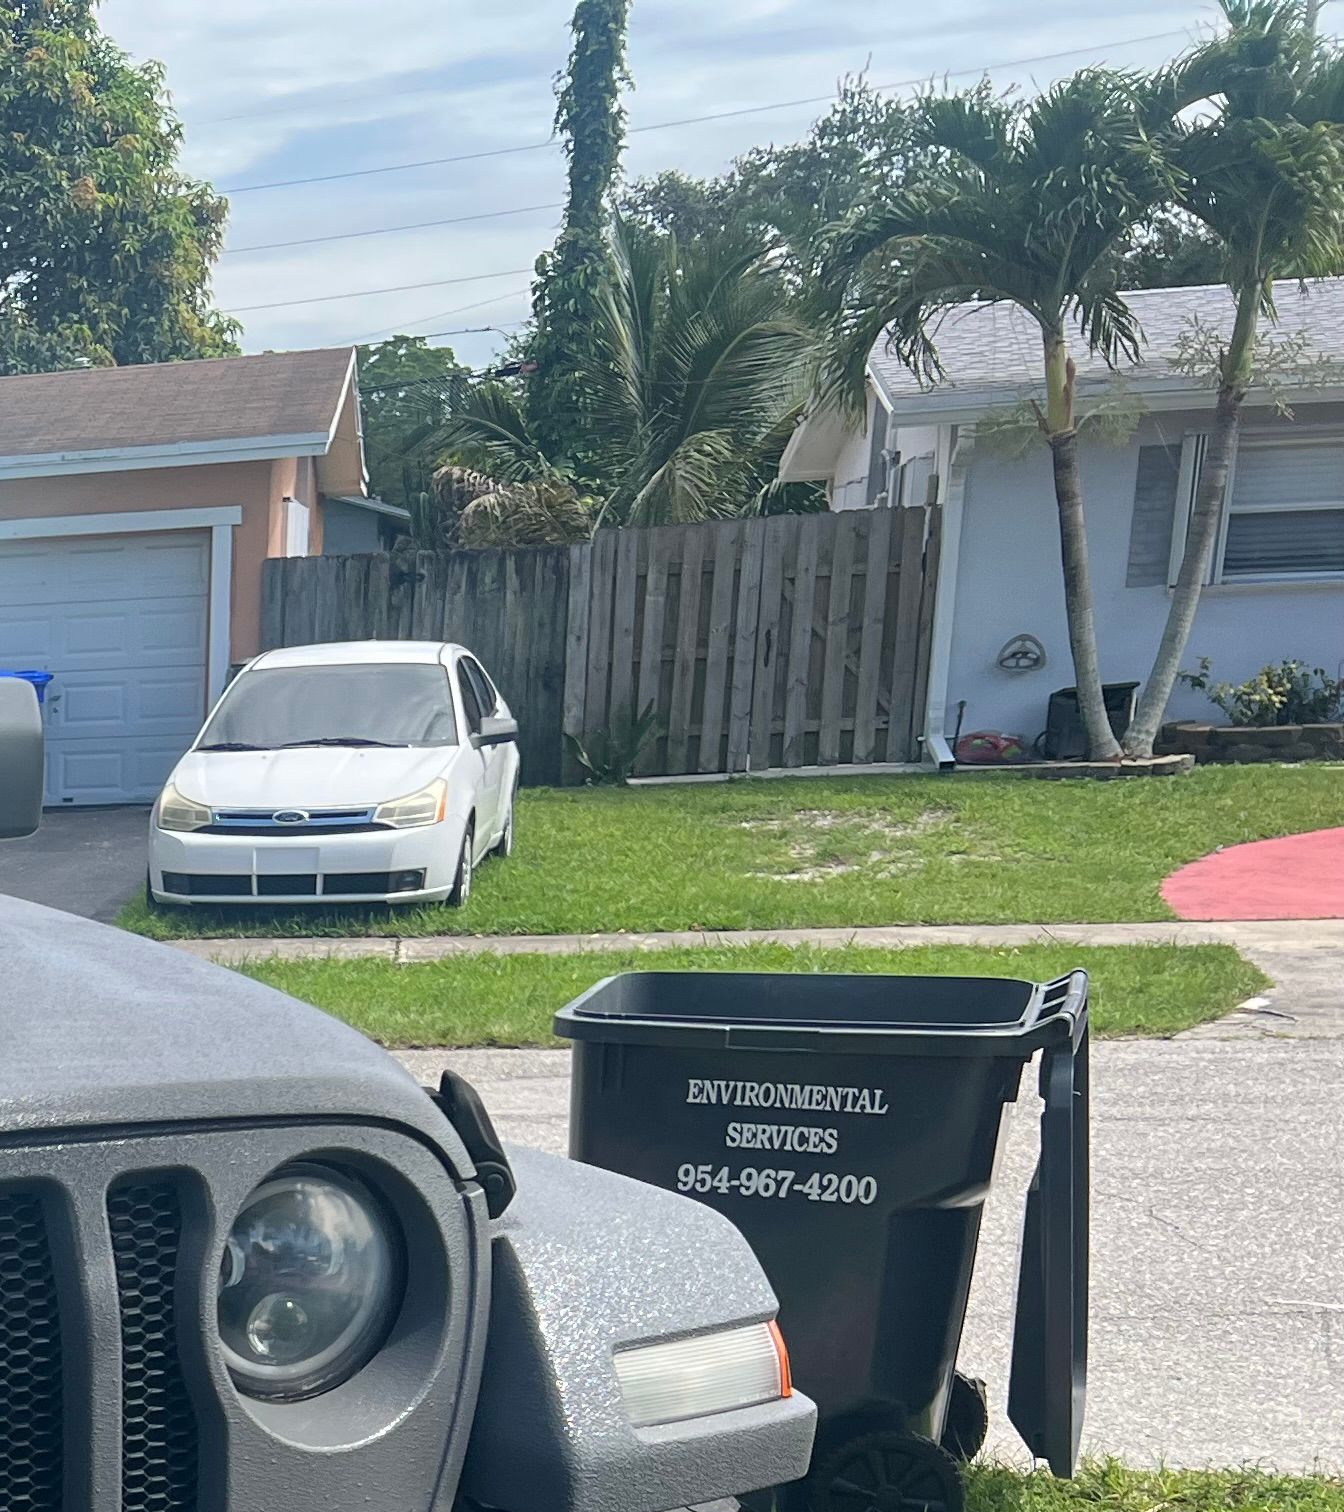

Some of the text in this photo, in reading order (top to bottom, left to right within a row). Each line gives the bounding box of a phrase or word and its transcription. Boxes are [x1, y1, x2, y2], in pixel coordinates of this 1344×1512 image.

[686, 1079, 889, 1114] ENVIRONMENTAL
[725, 1122, 838, 1154] SERVICES
[677, 1163, 878, 1205] 954-967-4200
